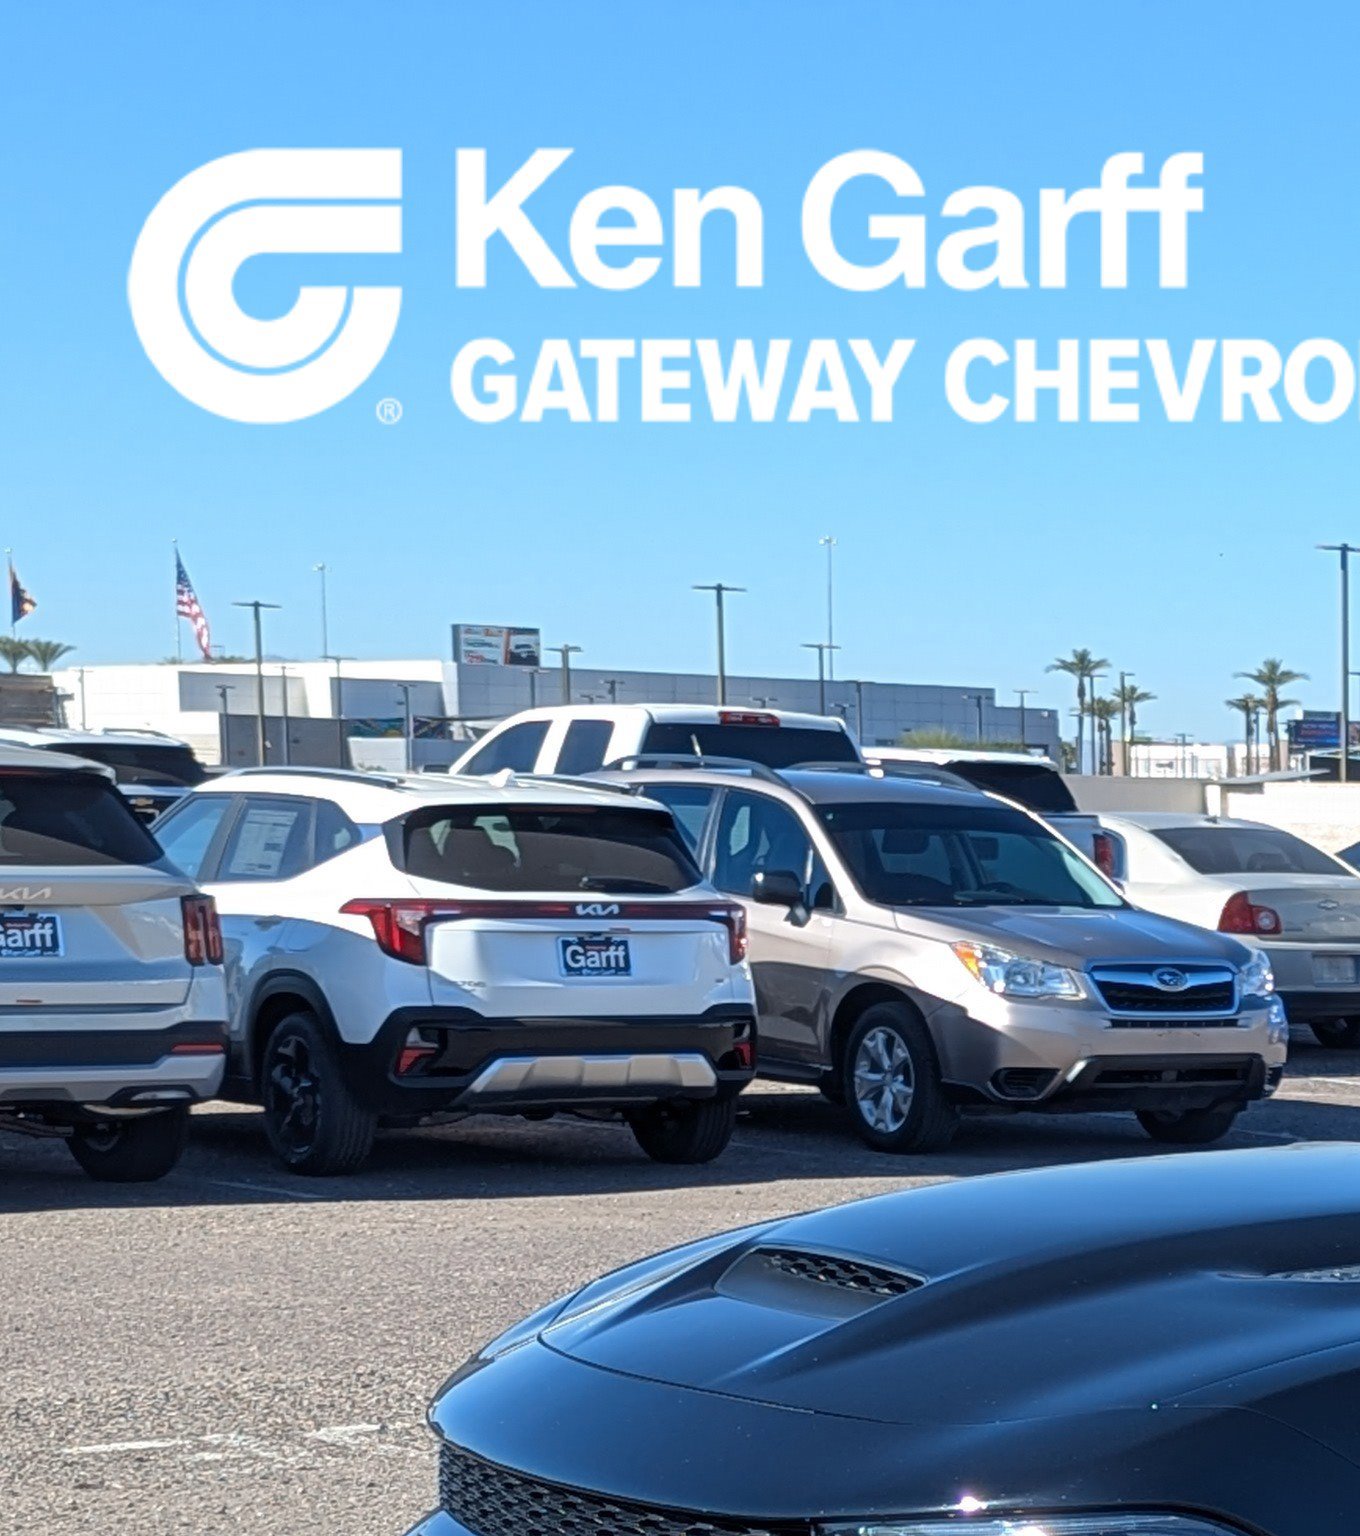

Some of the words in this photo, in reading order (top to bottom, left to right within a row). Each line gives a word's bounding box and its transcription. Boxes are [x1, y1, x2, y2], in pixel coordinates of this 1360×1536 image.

[575, 903, 620, 916] KIA
[0, 922, 53, 948] arff
[565, 944, 626, 969] Garff
